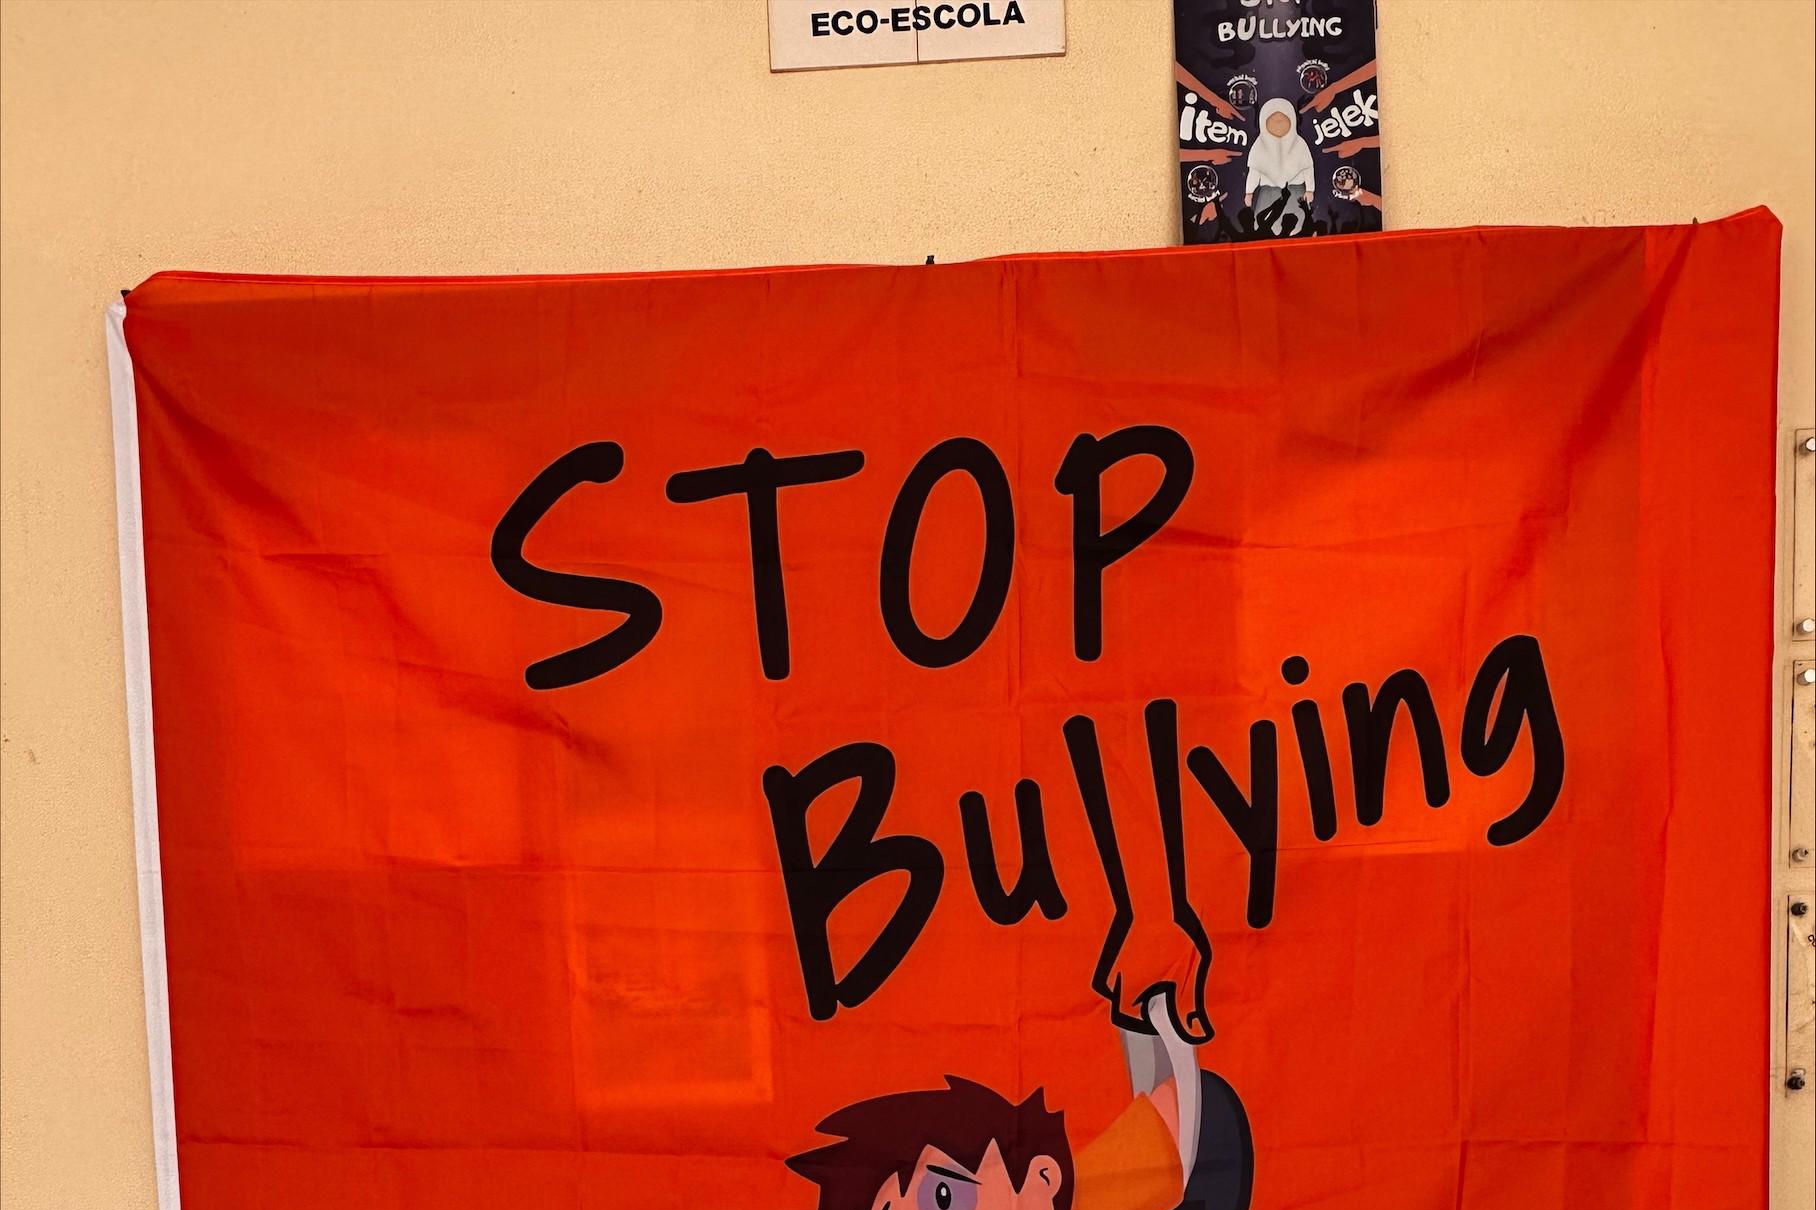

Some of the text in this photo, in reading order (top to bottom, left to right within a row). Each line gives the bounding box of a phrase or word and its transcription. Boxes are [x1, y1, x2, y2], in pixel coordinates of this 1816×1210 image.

[811, 1, 1025, 36] ECO-ESCOLA
[1217, 16, 1343, 42] BULLYING
[1179, 92, 1248, 146] item
[1312, 89, 1379, 145] jelek
[491, 424, 1195, 690] STOP
[762, 634, 1565, 1021] Bullying
